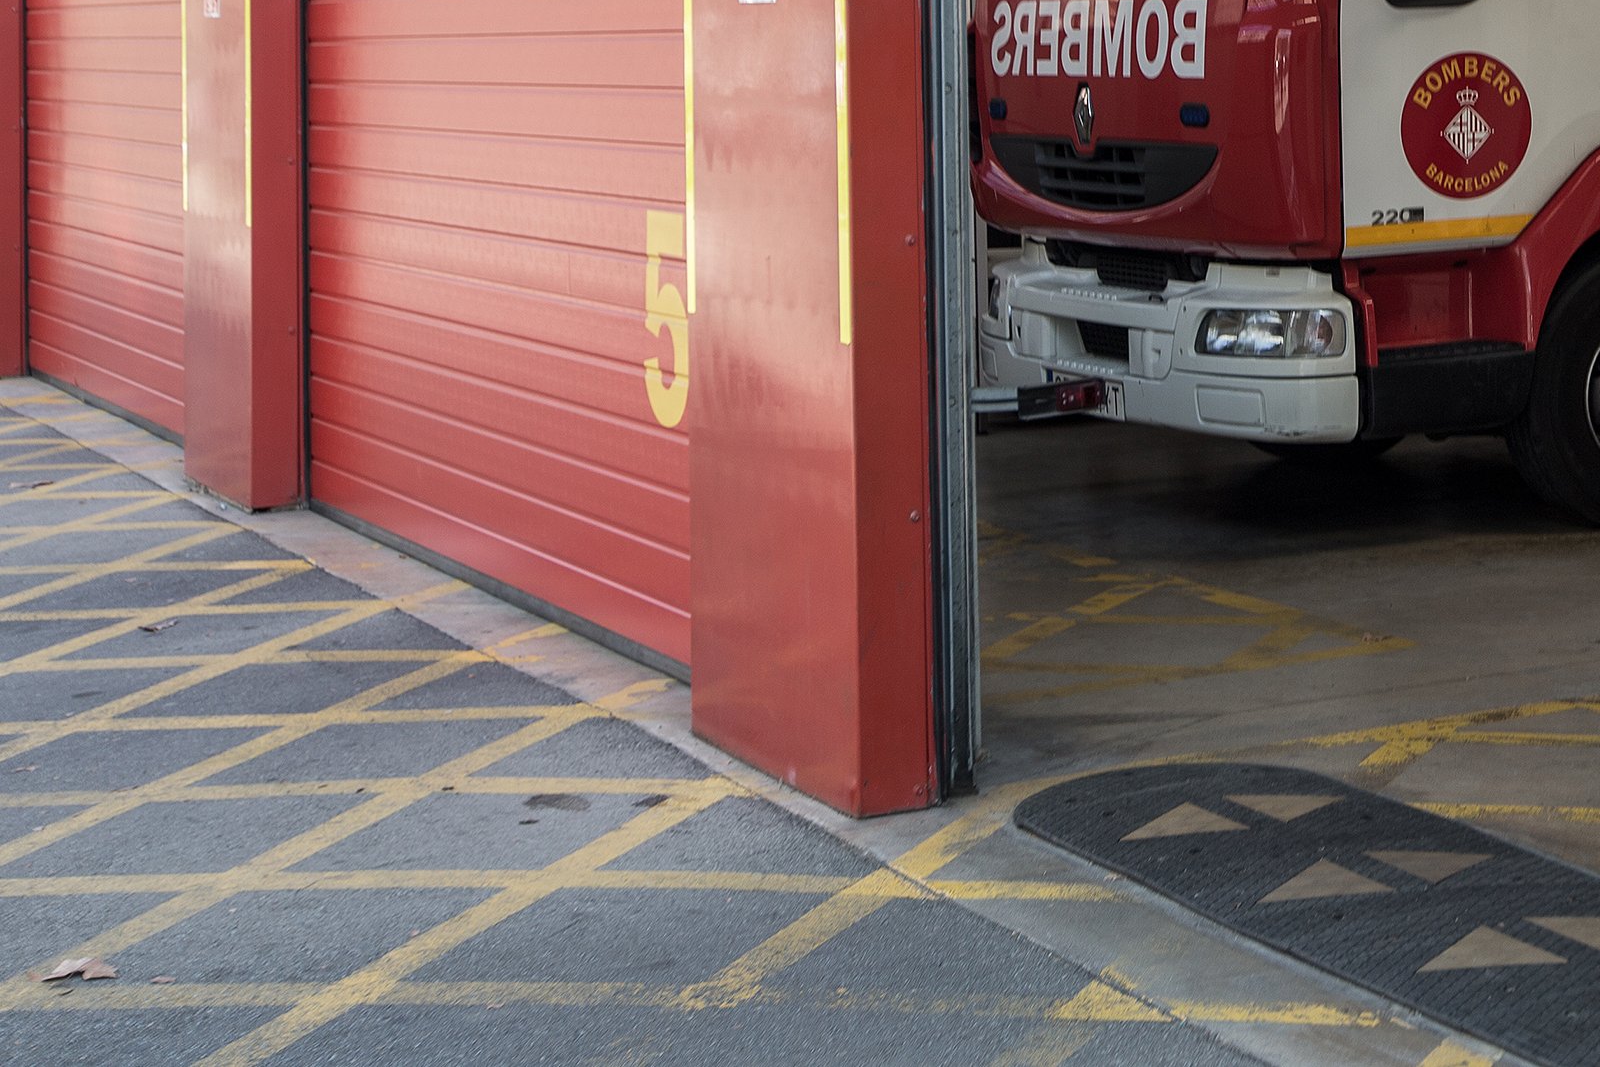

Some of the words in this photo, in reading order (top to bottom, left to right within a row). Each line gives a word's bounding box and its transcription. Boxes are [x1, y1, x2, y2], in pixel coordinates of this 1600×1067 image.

[1413, 55, 1521, 110] BOMBERS
[1425, 160, 1509, 193] BARCELONA
[1371, 207, 1411, 227] 220
[643, 210, 690, 429] 5
